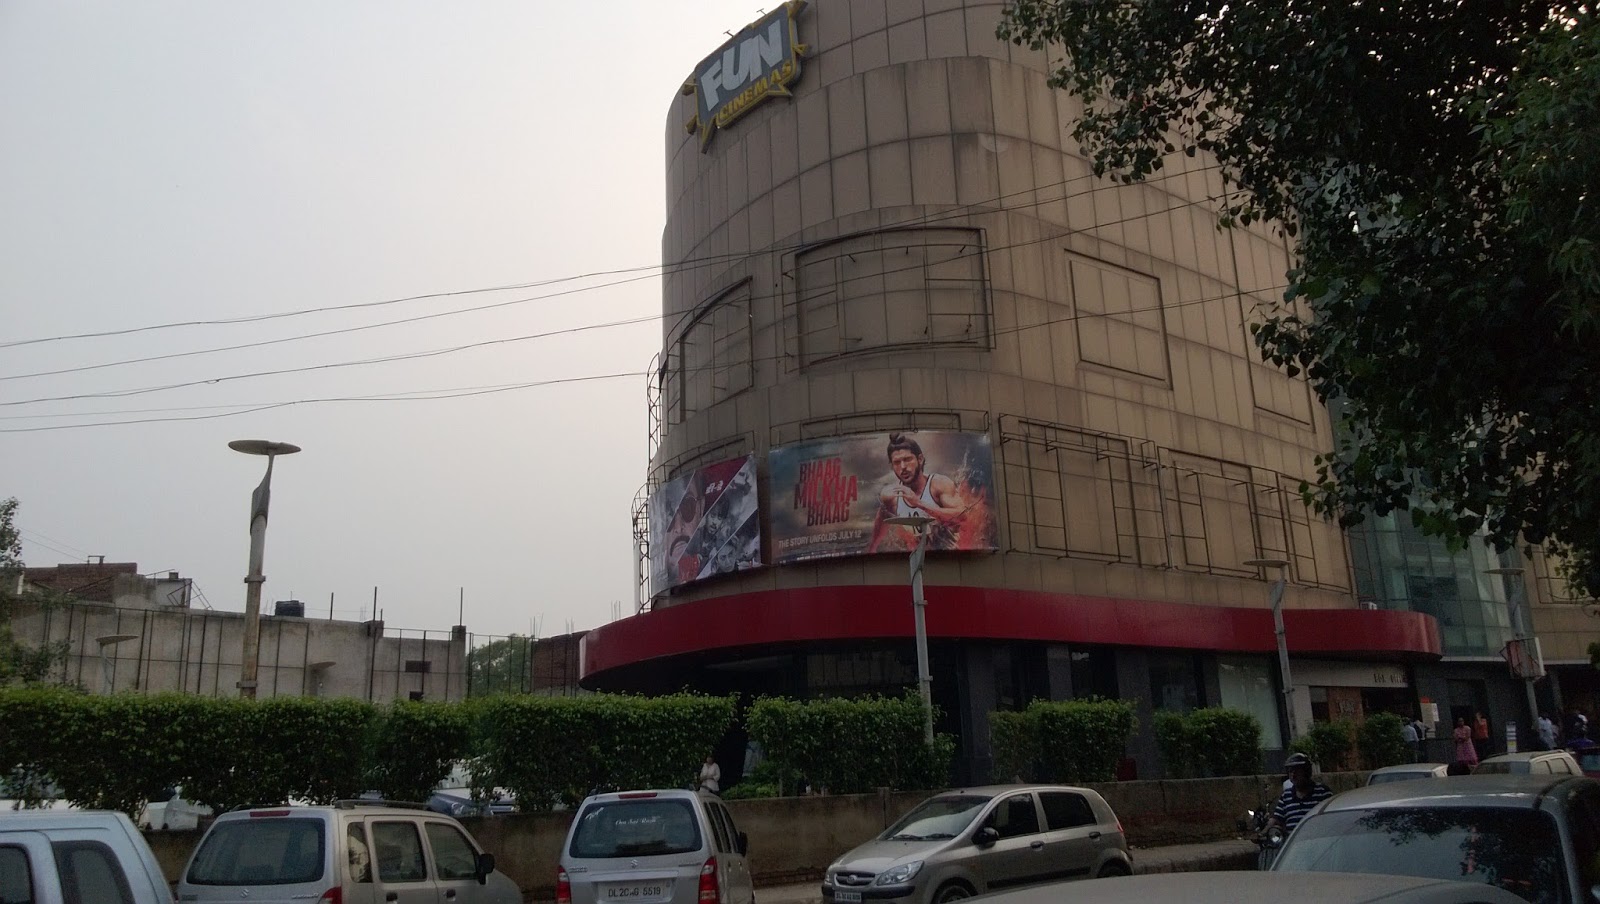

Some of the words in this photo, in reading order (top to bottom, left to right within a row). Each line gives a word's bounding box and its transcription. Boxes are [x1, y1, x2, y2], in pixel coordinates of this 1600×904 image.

[701, 19, 783, 112] FUN
[719, 60, 792, 121] CINEMAS
[800, 457, 842, 482] BHAAG
[794, 475, 858, 509] MILKHA
[807, 501, 850, 526] BHAAG
[778, 539, 790, 549] THE
[790, 536, 809, 547] STORY
[809, 532, 838, 544] UNFOLDS
[838, 530, 854, 540] JULY
[854, 529, 863, 538] 12
